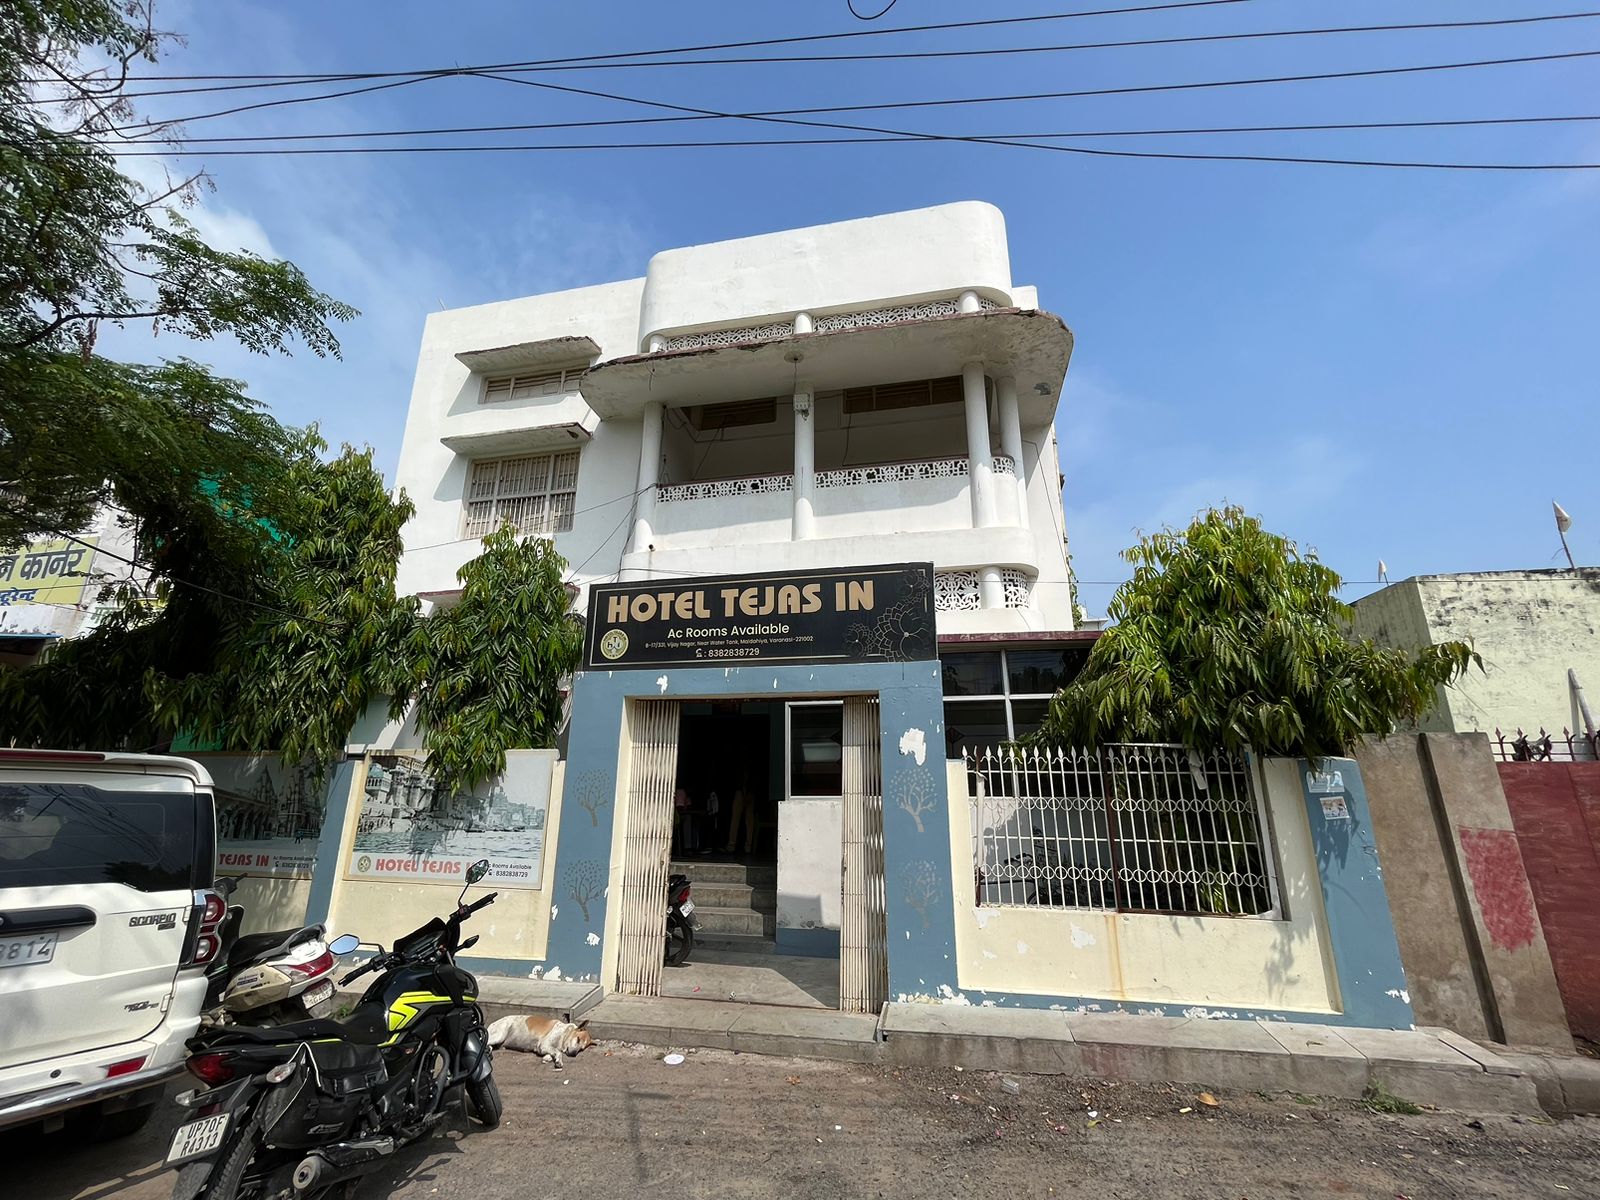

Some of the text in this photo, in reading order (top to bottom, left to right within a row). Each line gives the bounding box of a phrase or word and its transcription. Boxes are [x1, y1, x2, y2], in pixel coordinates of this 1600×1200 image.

[607, 580, 875, 623] HOTEL TEJAS IN
[667, 623, 790, 639] Ac Rooms Available
[708, 648, 760, 658] 8382838729
[219, 853, 269, 867] TEJAS IN
[375, 858, 418, 872] HOTEL
[421, 859, 461, 874] TEJAS
[129, 912, 177, 927] SCORPIO
[187, 1115, 226, 1140] UP70F
